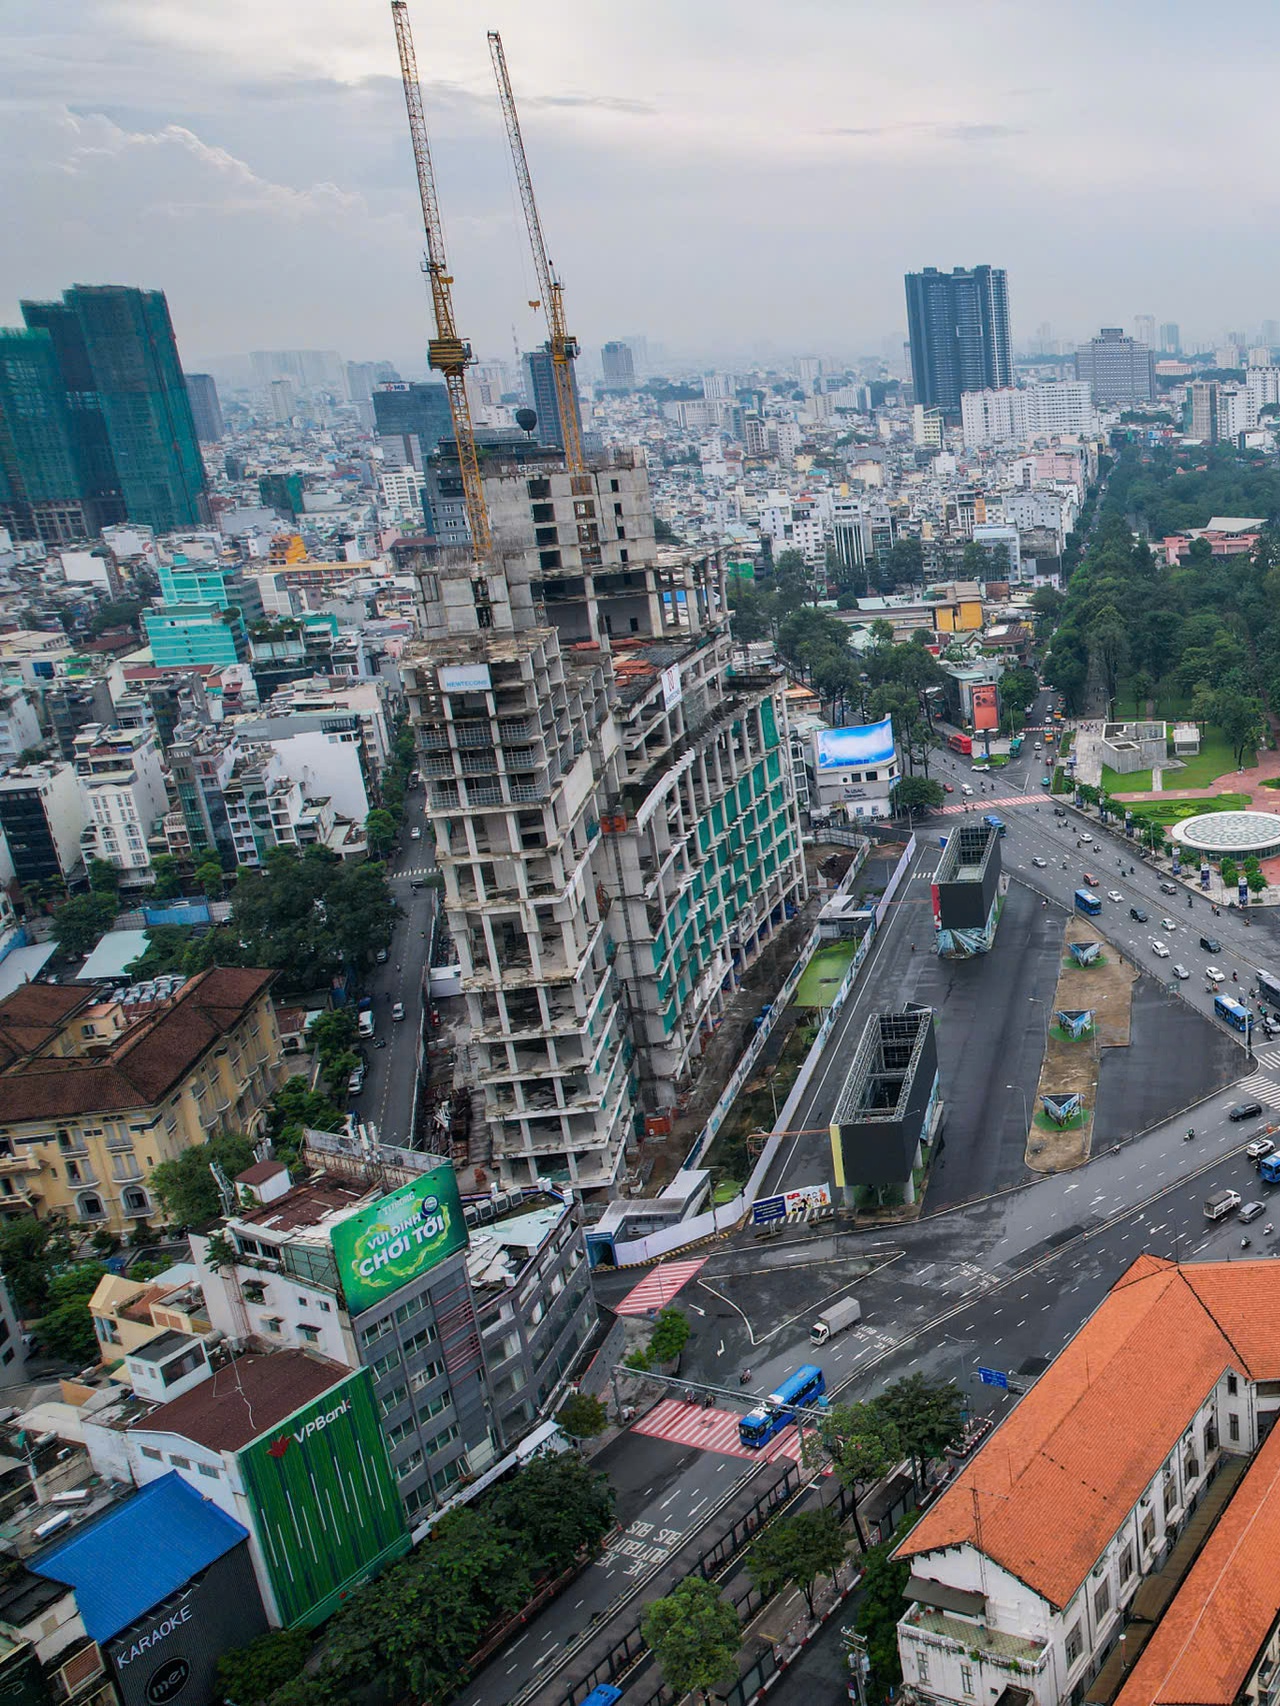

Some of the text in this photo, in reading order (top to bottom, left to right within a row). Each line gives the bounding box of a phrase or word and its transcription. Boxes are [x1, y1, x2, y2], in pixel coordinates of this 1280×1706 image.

[359, 1234, 411, 1278] CHƠI
[412, 1214, 445, 1244] TỚI
[367, 1232, 390, 1250] VUI
[293, 1398, 352, 1444] VPBank
[625, 1521, 655, 1537] BUS
[653, 1528, 682, 1546] BUS
[594, 1551, 619, 1568] XE
[622, 1559, 648, 1577] XE
[116, 1604, 193, 1669] KARAOKE
